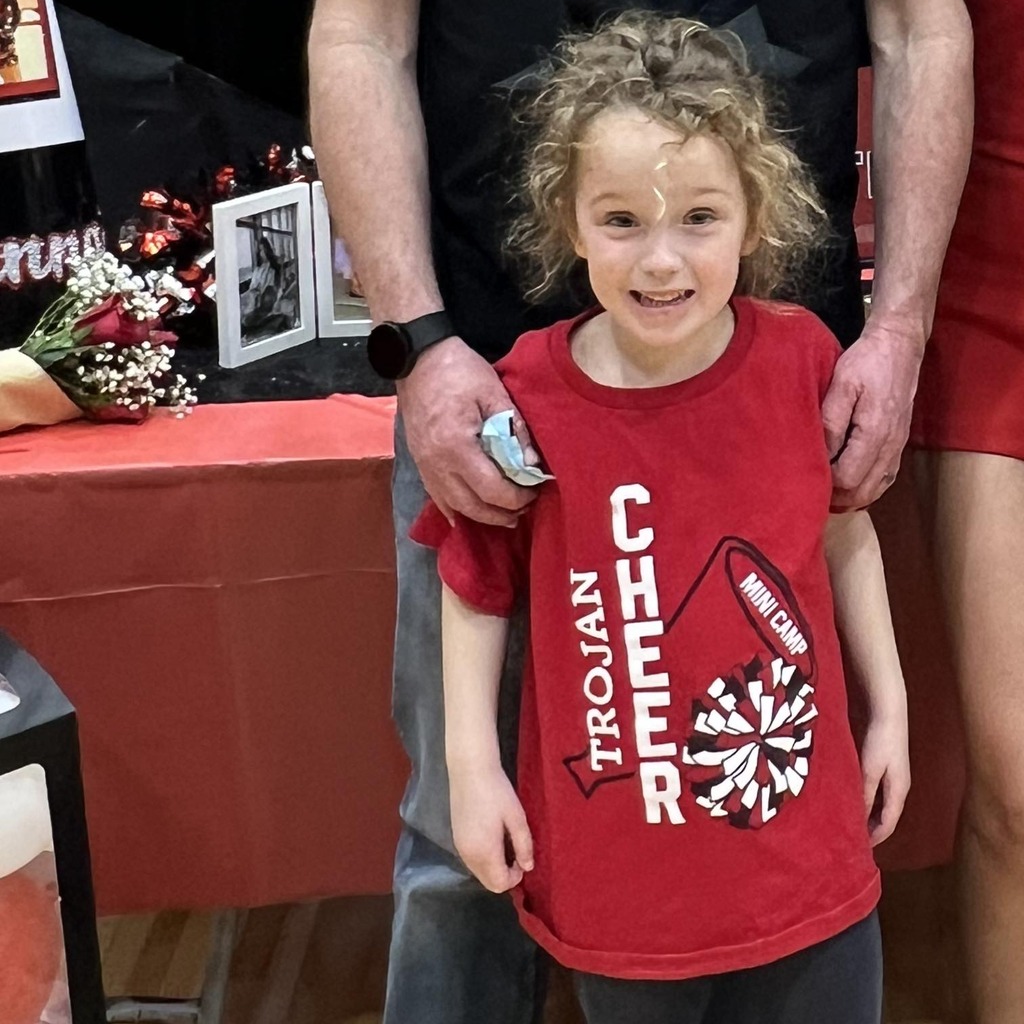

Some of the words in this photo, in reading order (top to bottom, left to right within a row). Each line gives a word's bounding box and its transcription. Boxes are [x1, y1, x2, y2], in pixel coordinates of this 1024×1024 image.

[570, 568, 623, 772] TROJAN
[609, 483, 686, 825] CHEER
[739, 571, 779, 618] MINI
[769, 610, 808, 655] CAMP
